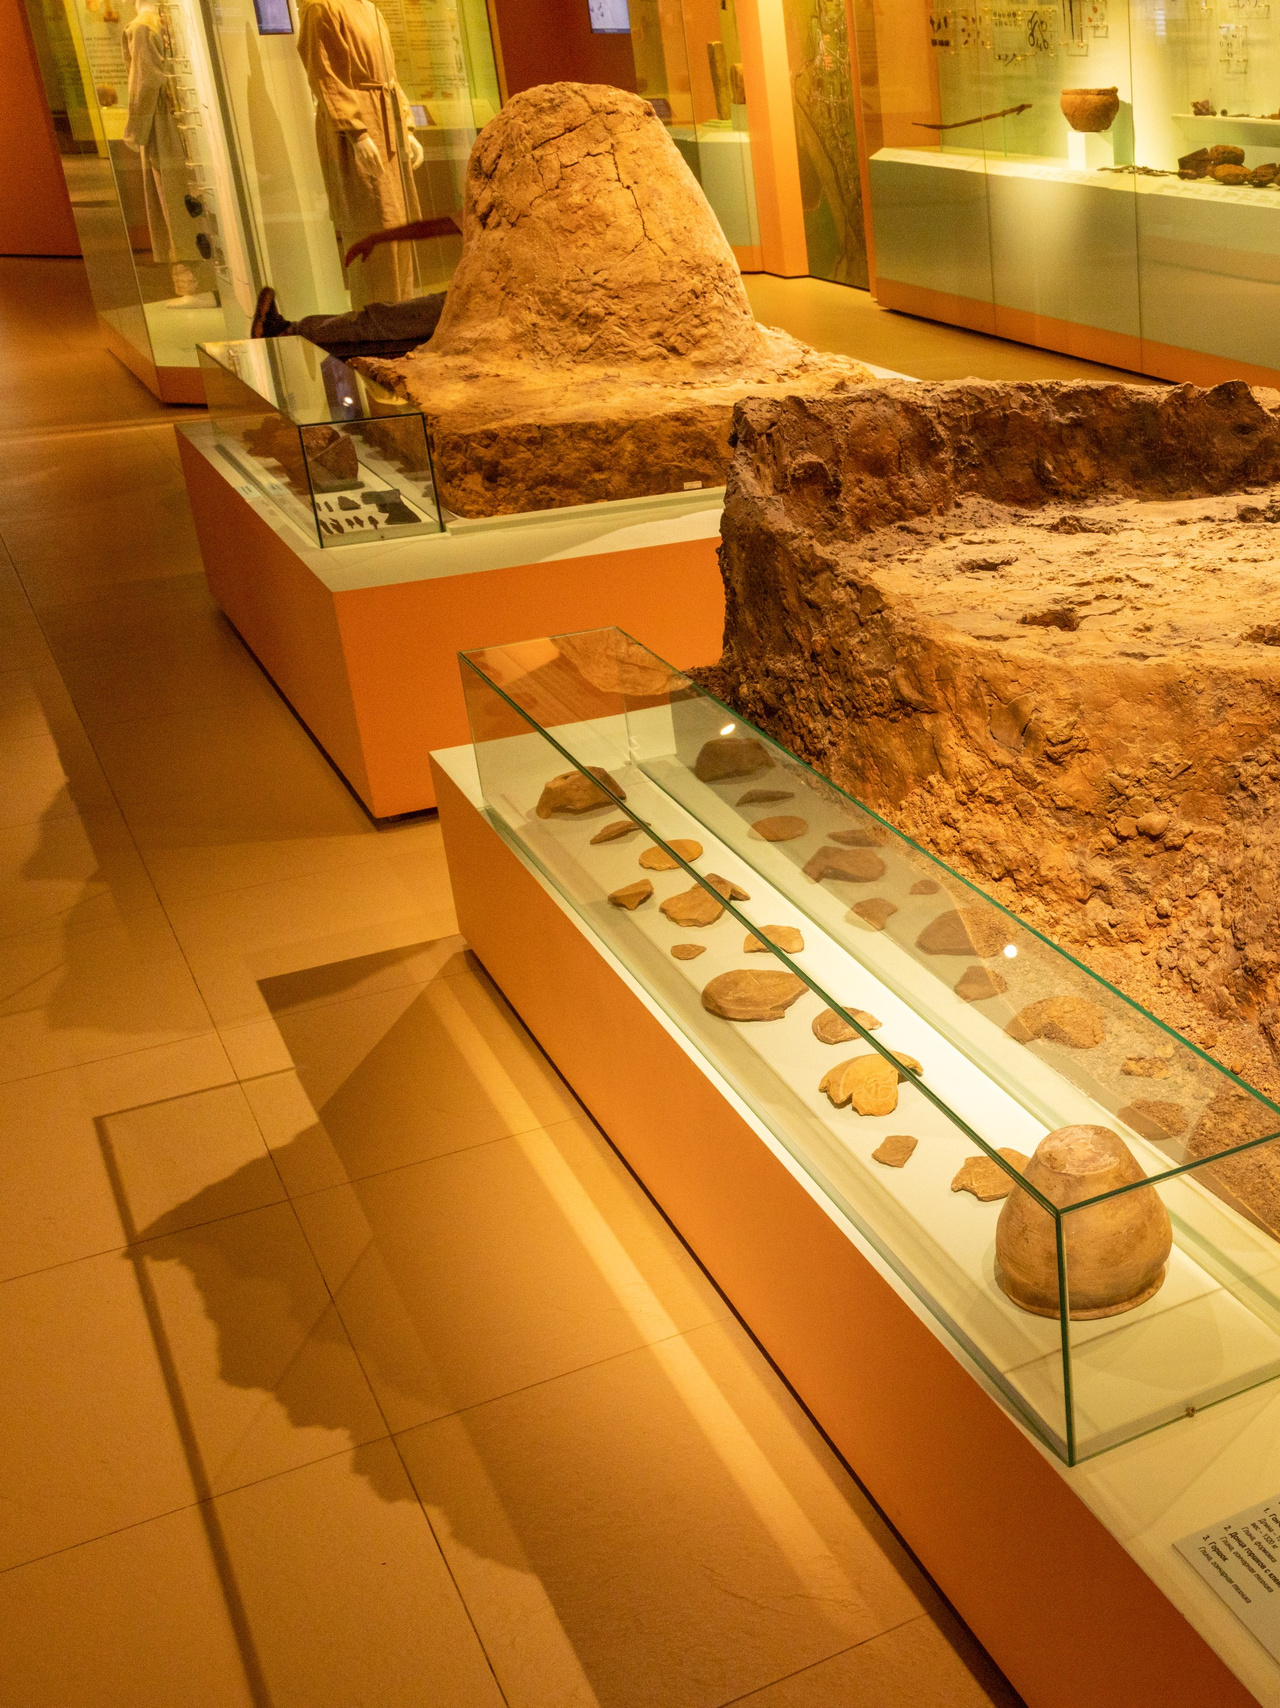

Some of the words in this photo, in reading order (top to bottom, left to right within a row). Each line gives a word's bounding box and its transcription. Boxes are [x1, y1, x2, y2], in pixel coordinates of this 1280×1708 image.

[1208, 1541, 1228, 1562] Горшок
[1228, 1531, 1247, 1549] Донца
[1244, 1547, 1267, 1570] горшков
